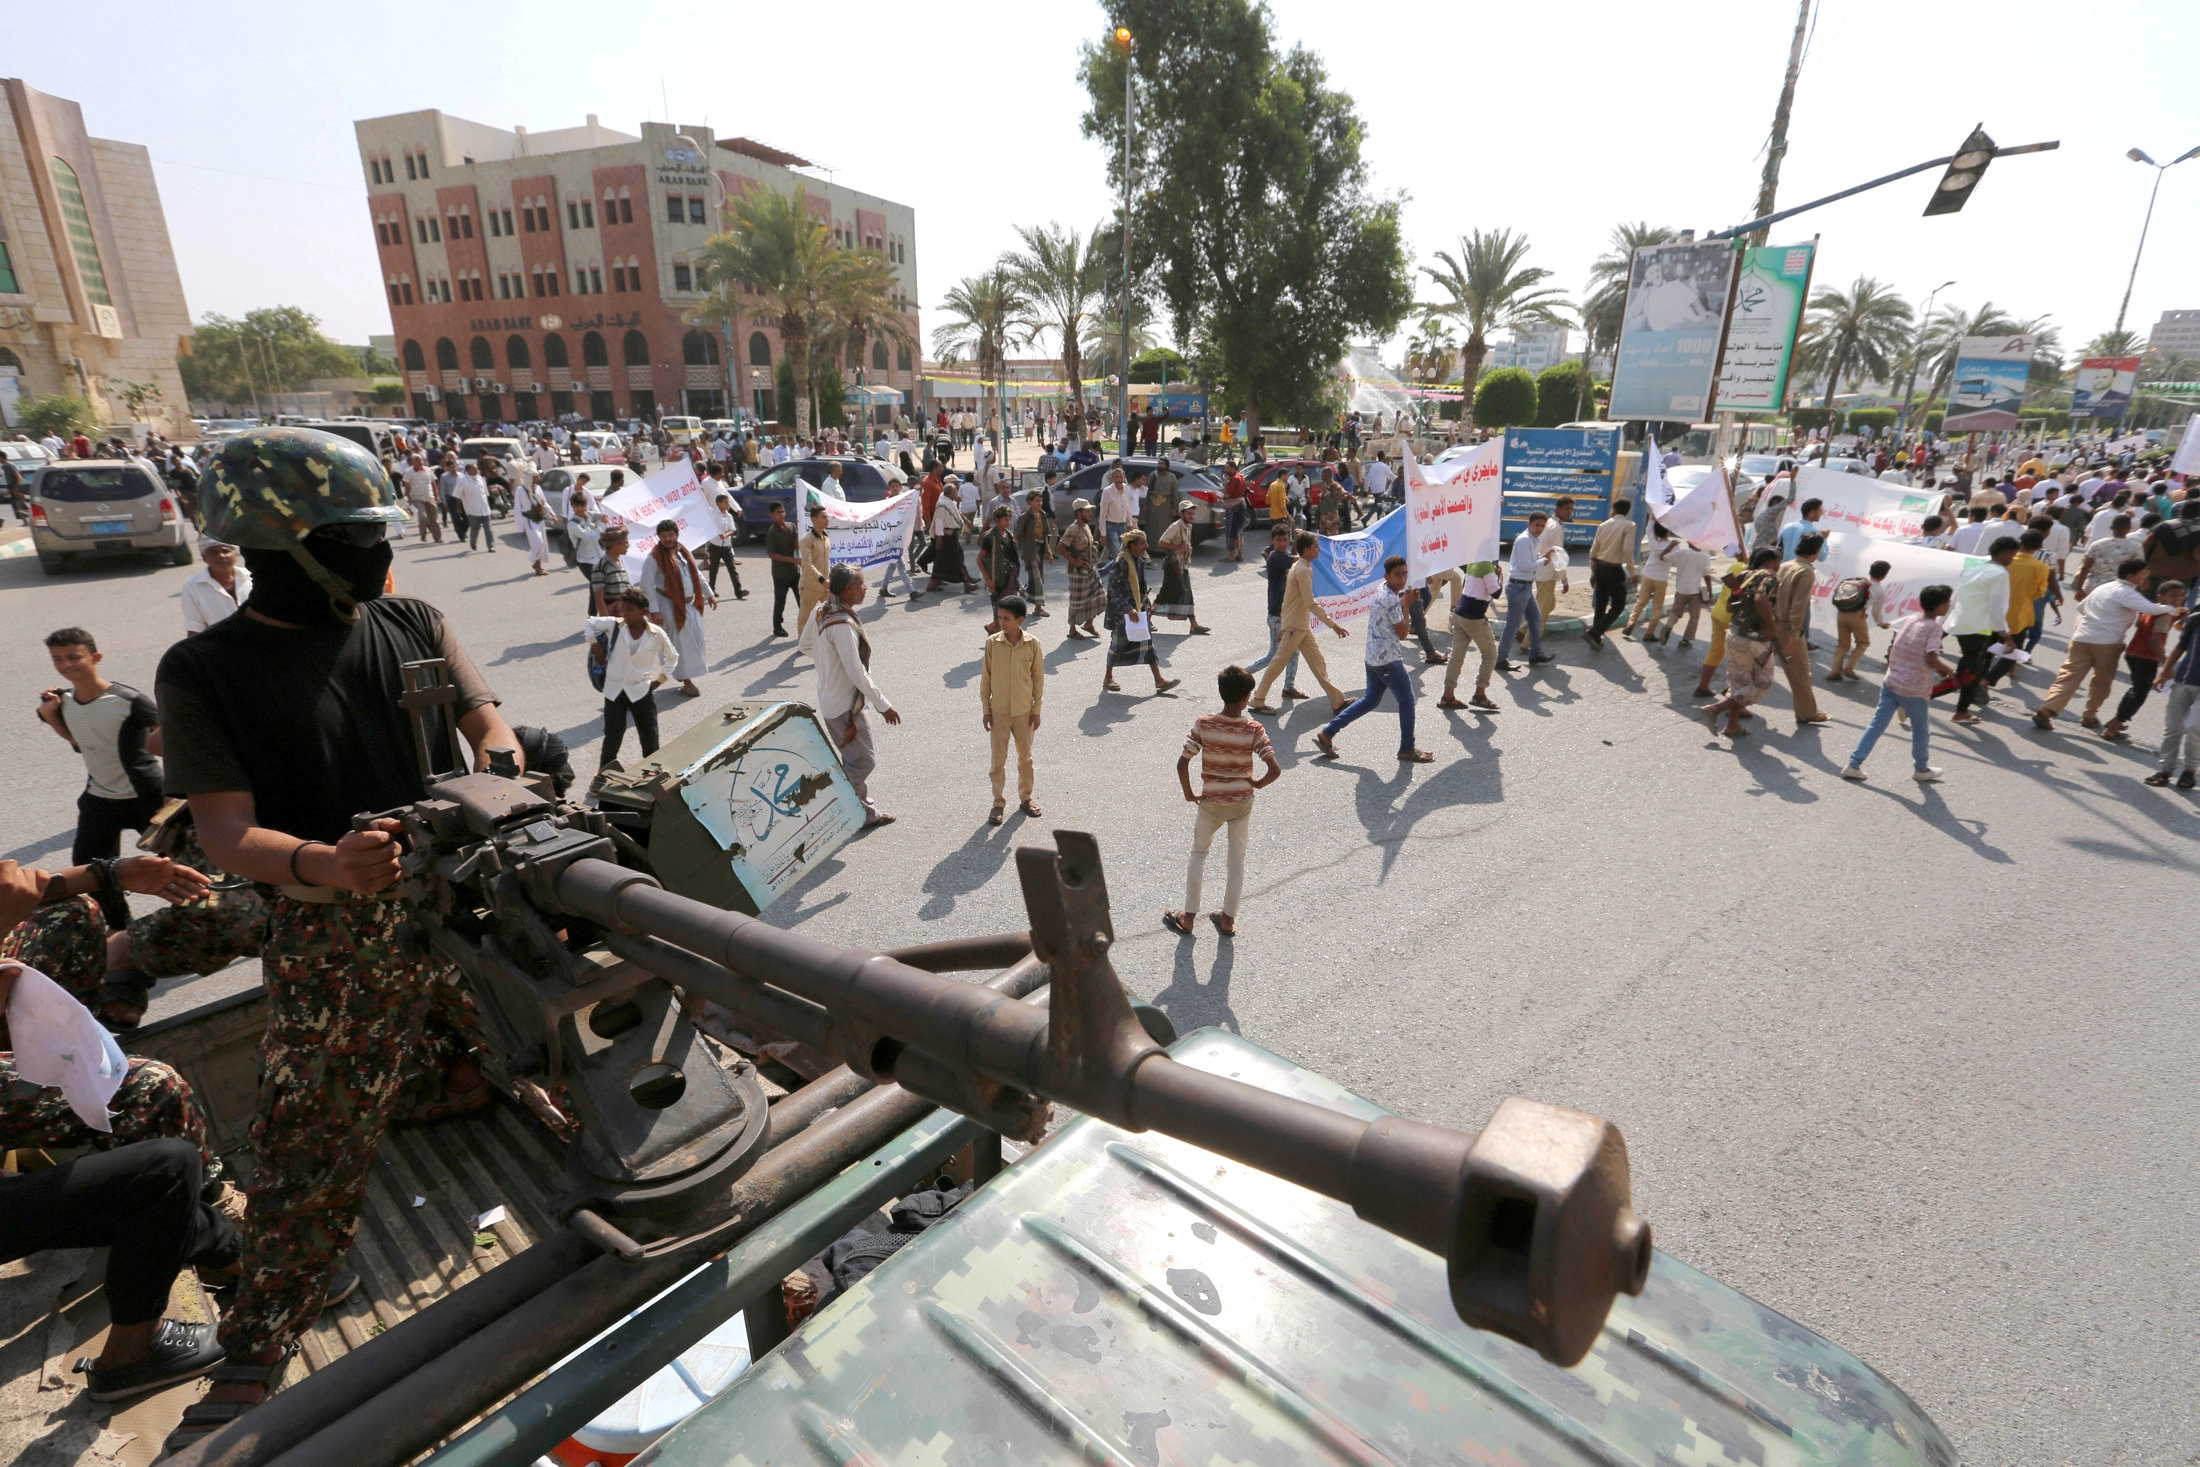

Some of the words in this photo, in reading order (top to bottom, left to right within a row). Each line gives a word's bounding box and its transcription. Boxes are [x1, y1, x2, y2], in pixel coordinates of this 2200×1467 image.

[659, 175, 684, 184] ARAB
[685, 177, 709, 185] BANK
[471, 317, 501, 332] ARAB
[503, 316, 533, 331] BANK
[1677, 338, 1712, 354] 1000
[1725, 342, 1750, 353] المول
[637, 499, 655, 517] lead
[652, 496, 667, 511] the
[664, 489, 680, 504] war
[680, 478, 697, 497] and
[1310, 616, 1320, 629] UN
[1335, 607, 1358, 620] brave
